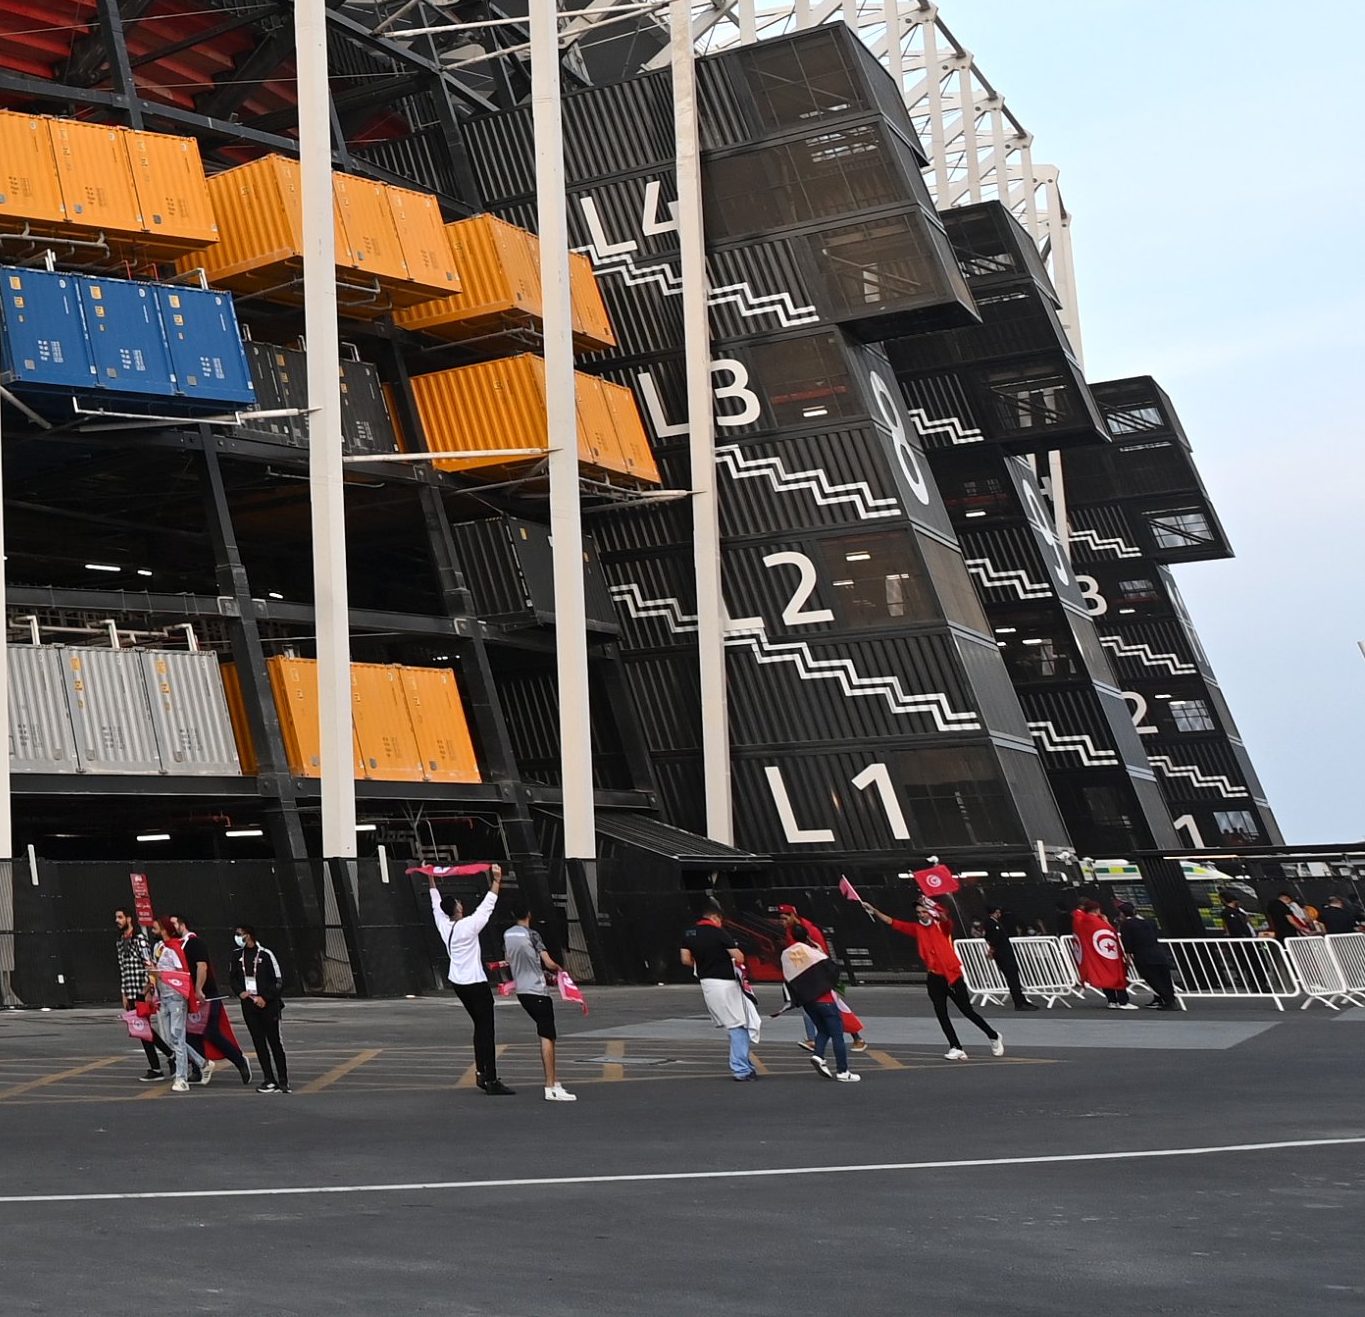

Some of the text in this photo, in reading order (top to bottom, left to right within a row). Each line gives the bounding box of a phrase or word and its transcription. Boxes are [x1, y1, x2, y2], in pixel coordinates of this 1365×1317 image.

[579, 180, 679, 258] L4
[636, 358, 762, 439] L3
[870, 370, 929, 507] 8
[765, 763, 911, 844] L1
